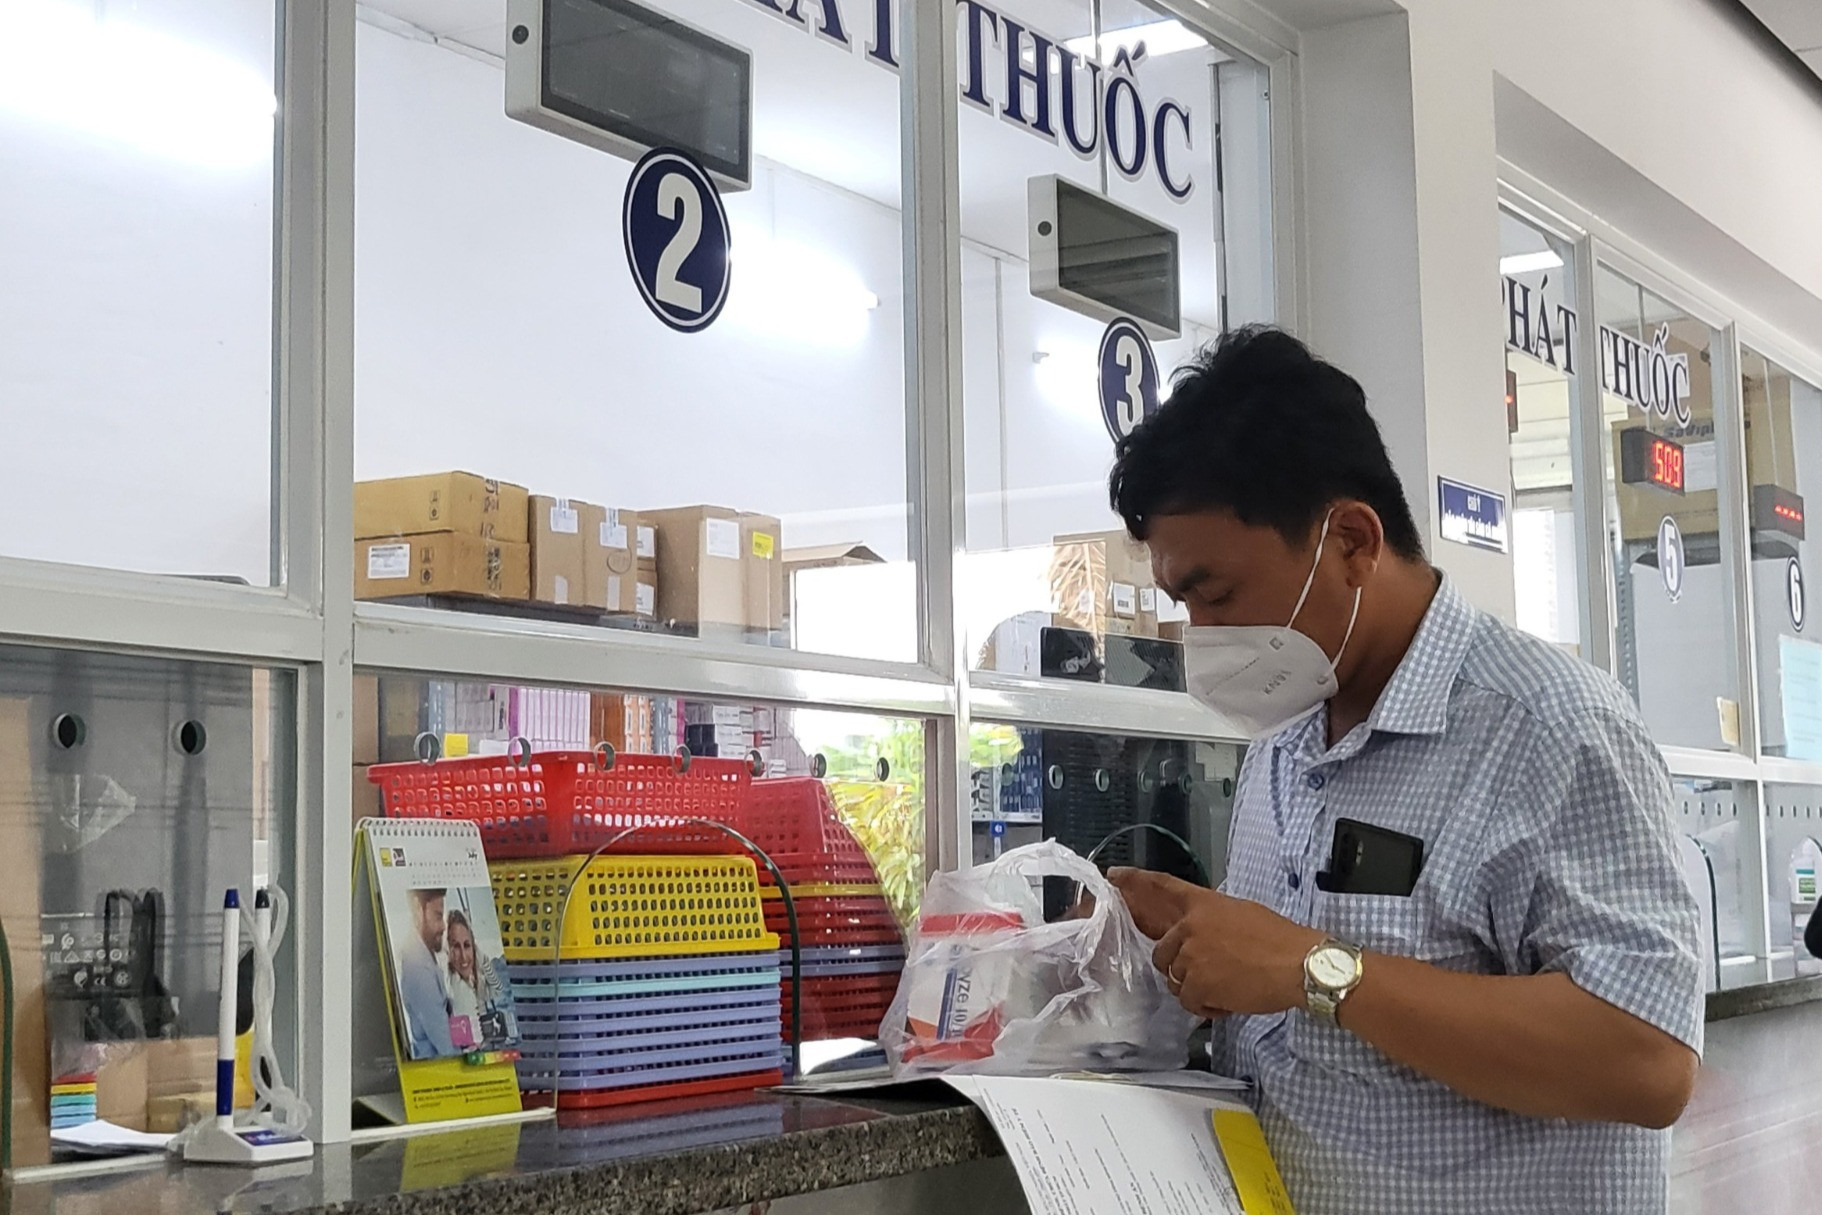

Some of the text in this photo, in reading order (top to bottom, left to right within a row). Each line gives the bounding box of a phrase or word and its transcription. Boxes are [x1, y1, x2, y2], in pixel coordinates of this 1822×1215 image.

[958, 0, 1193, 199] THUỐC
[655, 172, 702, 313] 2
[1502, 273, 1577, 375] HÁT
[1115, 335, 1144, 437] 3
[1654, 442, 1683, 489] 509
[1664, 522, 1679, 592] 5
[1790, 563, 1803, 624] 6
